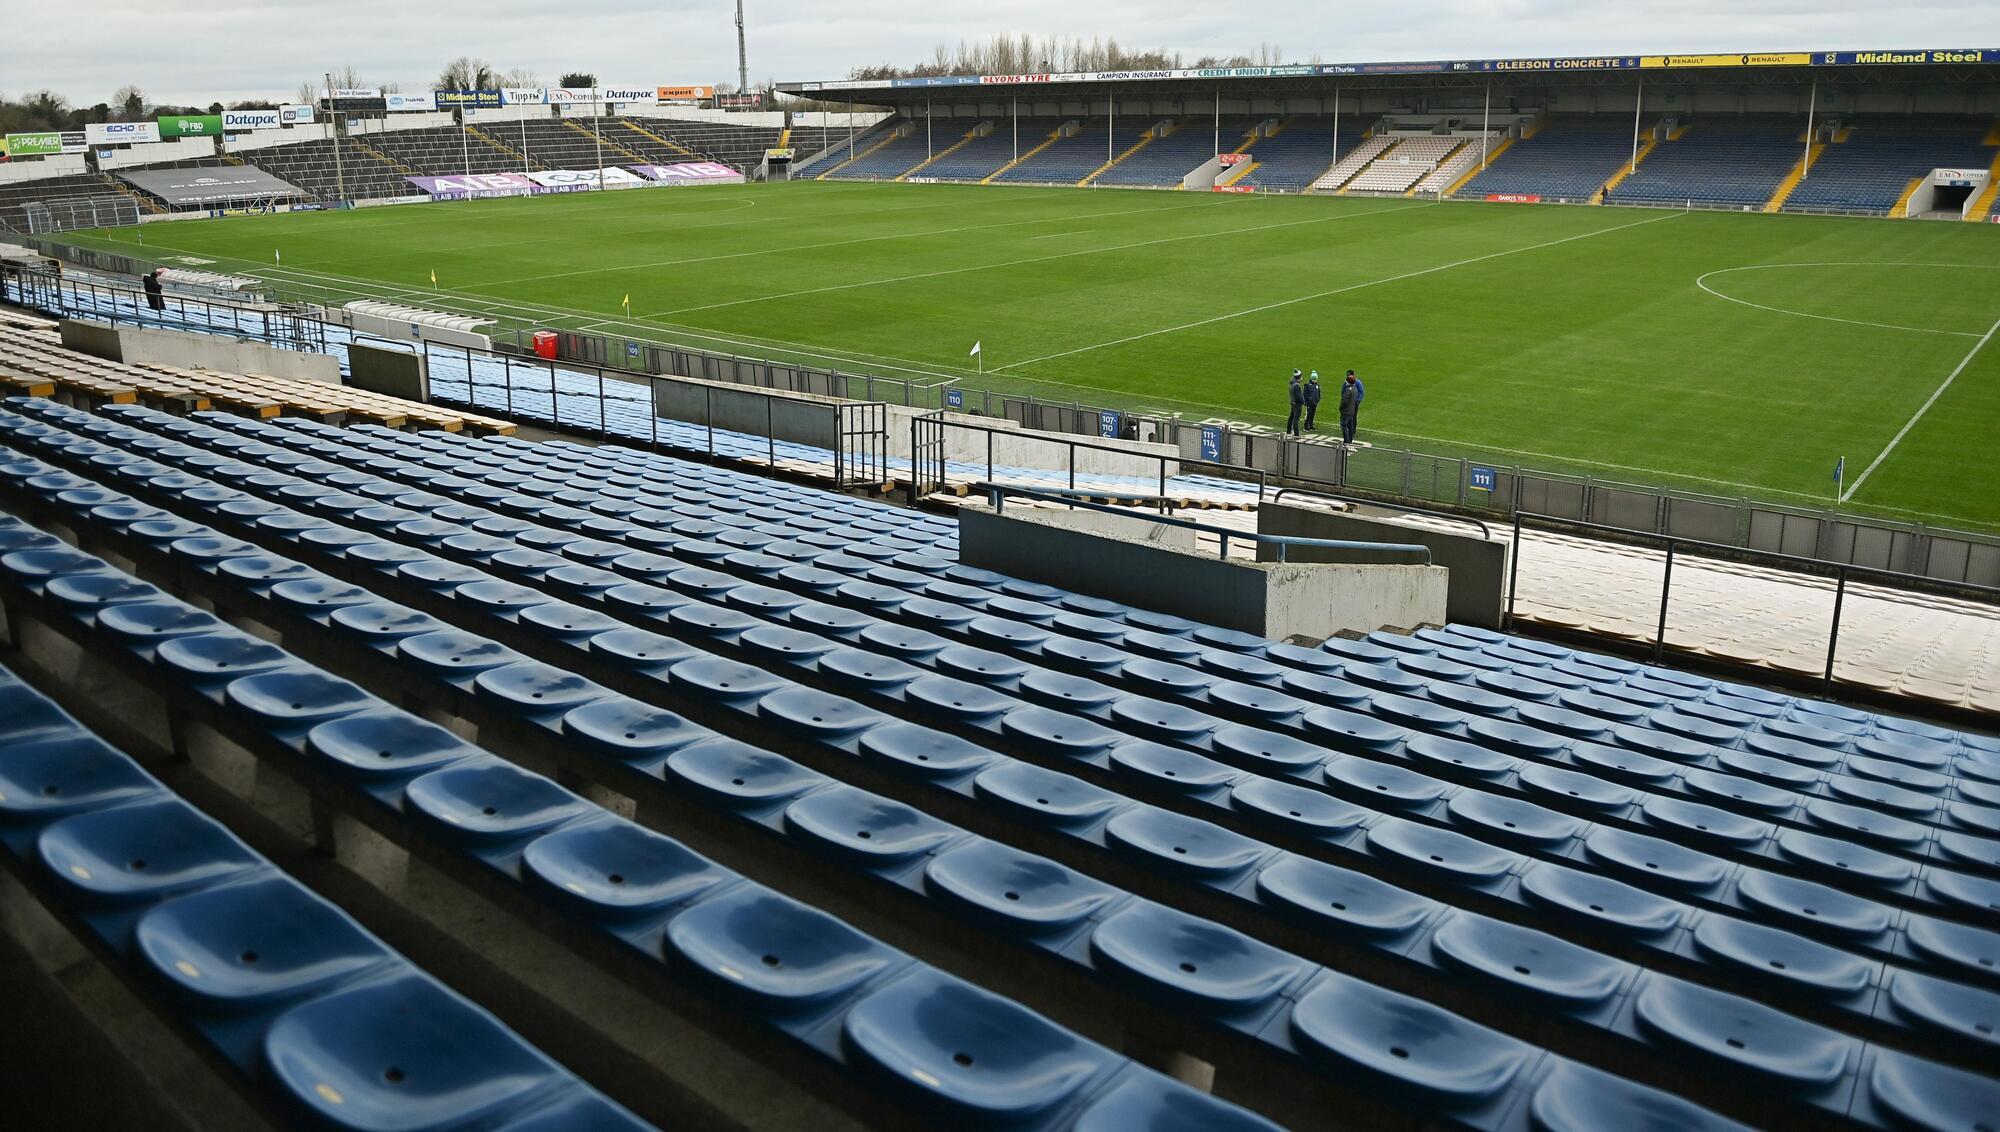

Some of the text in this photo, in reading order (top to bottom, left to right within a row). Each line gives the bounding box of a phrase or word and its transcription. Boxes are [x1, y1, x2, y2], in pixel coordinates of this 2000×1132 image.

[1855, 51, 1982, 63] Midland Steel
[1496, 58, 1620, 70] GLEESON CONCRETE
[1198, 69, 1233, 77] CREDIT
[1235, 67, 1268, 76] UNION
[989, 75, 1021, 83] LYONS
[1025, 74, 1051, 82] TYRE
[445, 93, 499, 101] Midland Steel
[509, 91, 529, 103] Tipp
[606, 89, 654, 100] Datapac
[225, 114, 277, 127] Datapac
[190, 122, 203, 130] FBD
[21, 136, 59, 146] PREMIER
[654, 165, 729, 179] AIB
[434, 175, 523, 191] AIB
[540, 186, 551, 194] AIB
[559, 185, 570, 193] AIB
[577, 184, 588, 192] AIB
[440, 193, 452, 201] AIB
[479, 190, 491, 198] AIB
[500, 189, 512, 197] AIB
[949, 396, 961, 405] 110
[1102, 416, 1117, 425] 107-
[1102, 424, 1113, 432] 110
[1203, 439, 1216, 449] 114
[1475, 474, 1490, 485] 111
